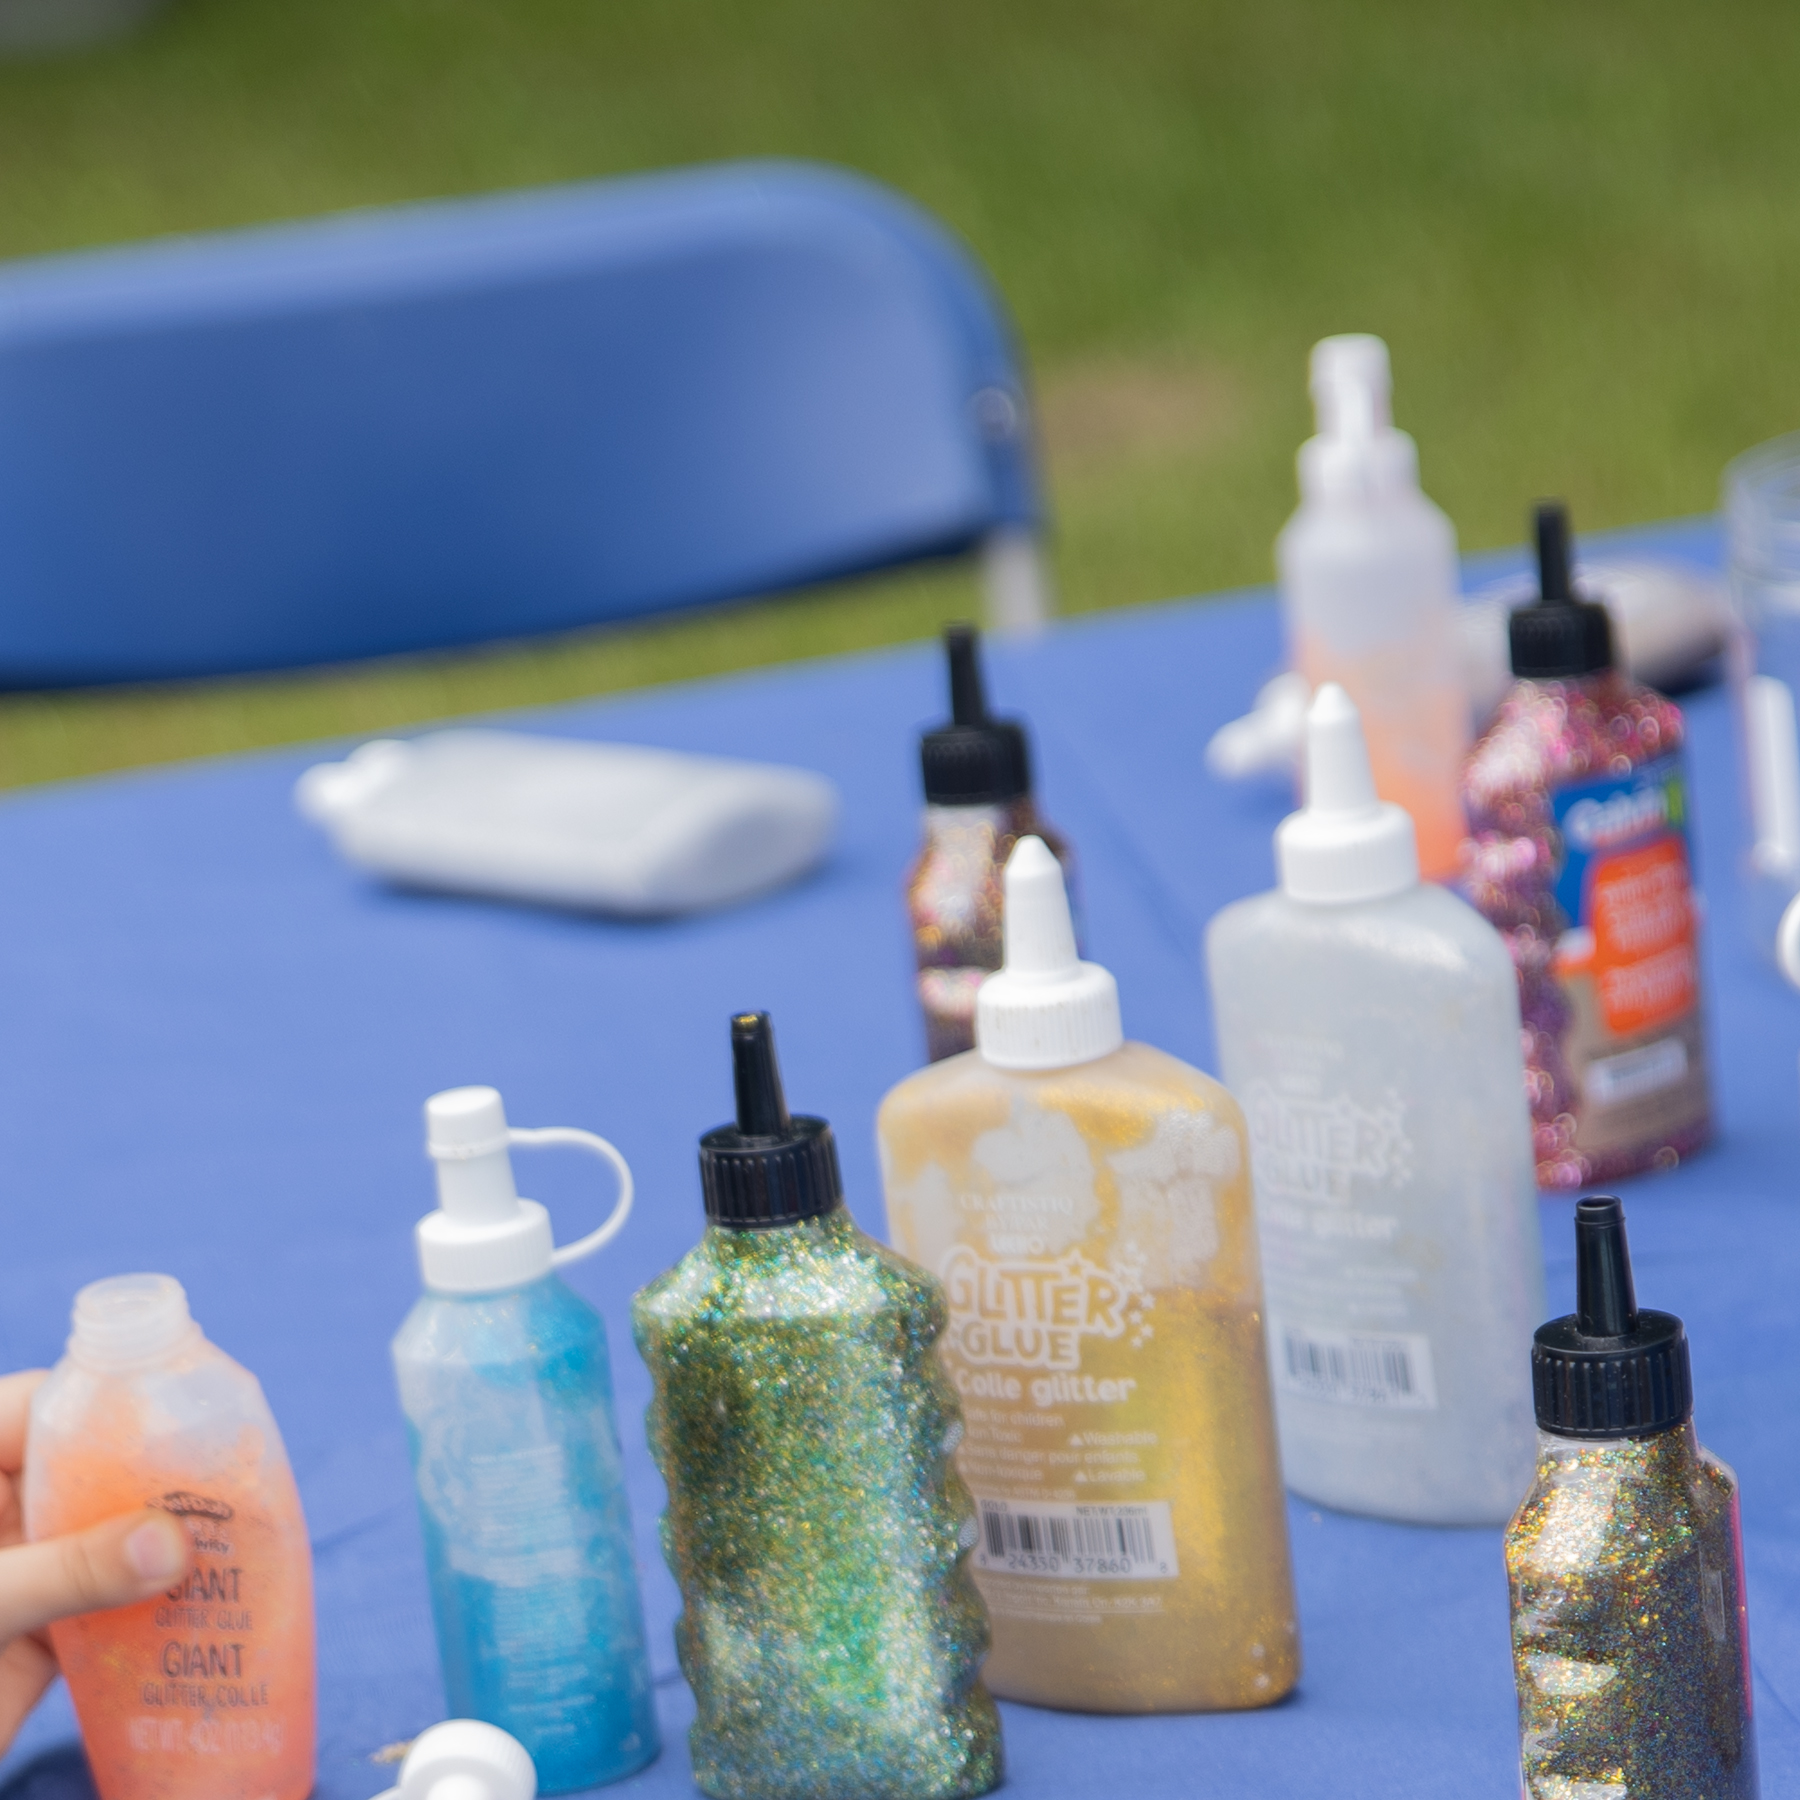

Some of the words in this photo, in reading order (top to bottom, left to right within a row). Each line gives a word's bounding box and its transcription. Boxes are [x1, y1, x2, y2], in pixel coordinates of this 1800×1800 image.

[942, 1247, 1127, 1337] GLITTER
[958, 1318, 1080, 1369] GLUE
[954, 1368, 1022, 1399] Colle
[1031, 1373, 1137, 1408] glitter
[1010, 1411, 1066, 1429] children
[1082, 1431, 1158, 1447] Washable
[998, 1447, 1045, 1465] danger
[1048, 1452, 1079, 1467] pour
[1088, 1469, 1145, 1483] Lavable
[1008, 1553, 1059, 1573] 24350
[1073, 1557, 1132, 1575] 37860
[1160, 1562, 1169, 1574] 8
[154, 1606, 209, 1629] GLITTER
[216, 1609, 253, 1631] GLUE
[161, 1640, 244, 1679] GIANT
[142, 1682, 206, 1708] GLITTER
[214, 1684, 269, 1708] COLLE
